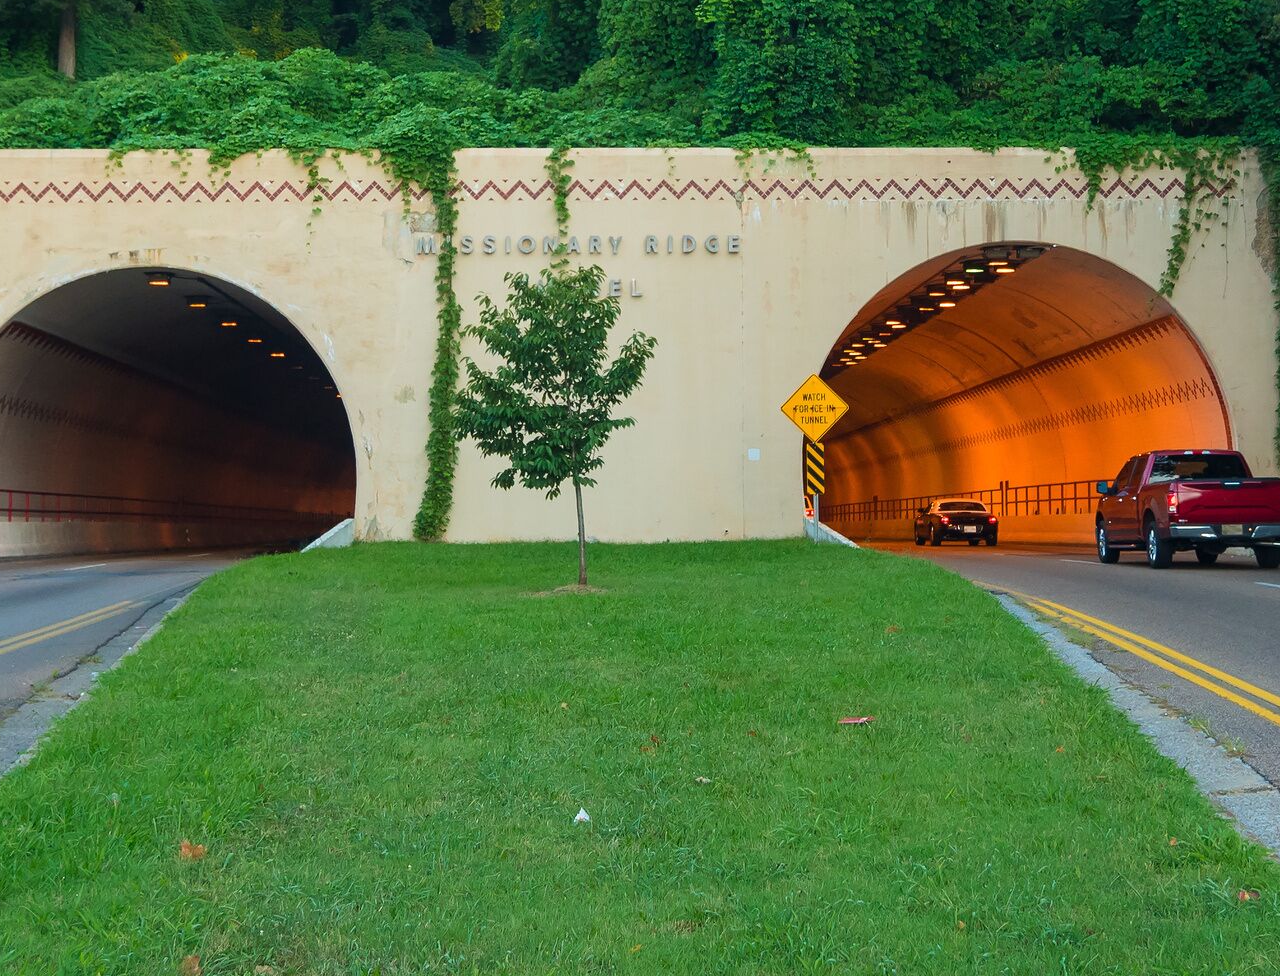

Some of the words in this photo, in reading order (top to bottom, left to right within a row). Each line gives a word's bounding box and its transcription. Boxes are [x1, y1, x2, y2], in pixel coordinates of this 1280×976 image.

[644, 234, 743, 255] RIDGE
[802, 393, 826, 402] WATCH
[795, 404, 809, 413] FOR
[812, 404, 824, 413] ICE
[826, 404, 834, 413] IN
[801, 416, 829, 425] TUNNEL
